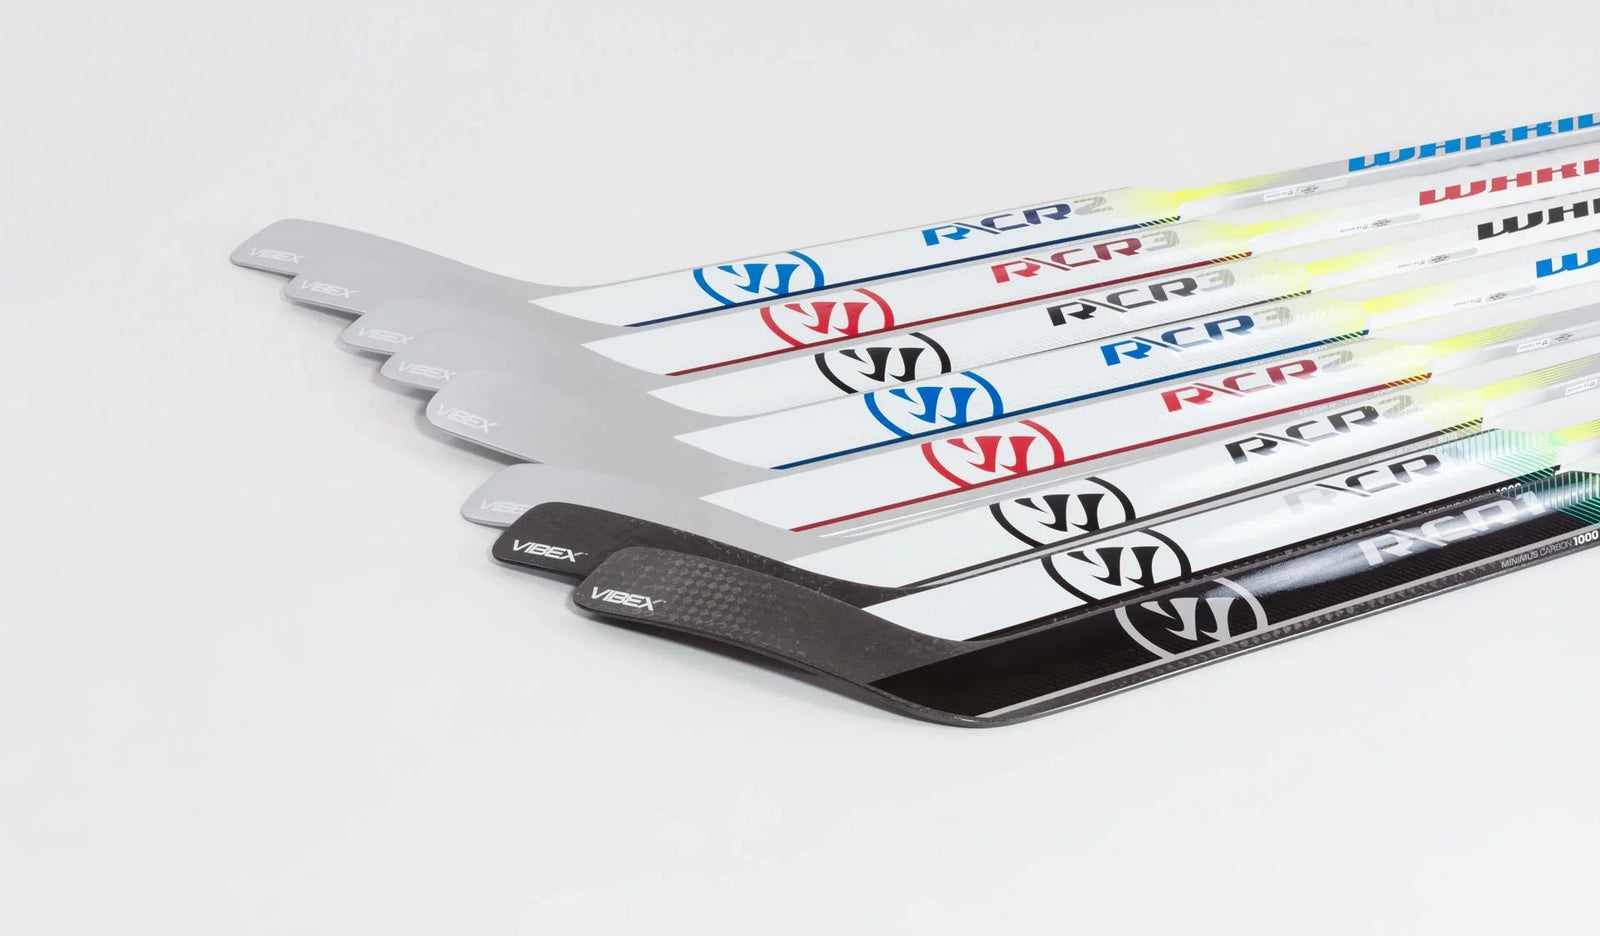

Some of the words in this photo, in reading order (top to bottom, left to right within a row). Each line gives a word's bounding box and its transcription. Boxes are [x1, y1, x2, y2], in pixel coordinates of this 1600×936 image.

[250, 248, 304, 264] VIBEX
[301, 280, 359, 298] VIBEX
[358, 326, 414, 345] VIBEX
[398, 361, 459, 381] VIBEX
[437, 403, 498, 433] VIBEX
[479, 499, 532, 515] VIBE
[512, 539, 584, 563] VIBEX
[1501, 550, 1539, 569] MINIMUS
[1539, 540, 1573, 556] CARBON
[1572, 530, 1599, 546] 1000
[591, 586, 662, 611] VIBEX
